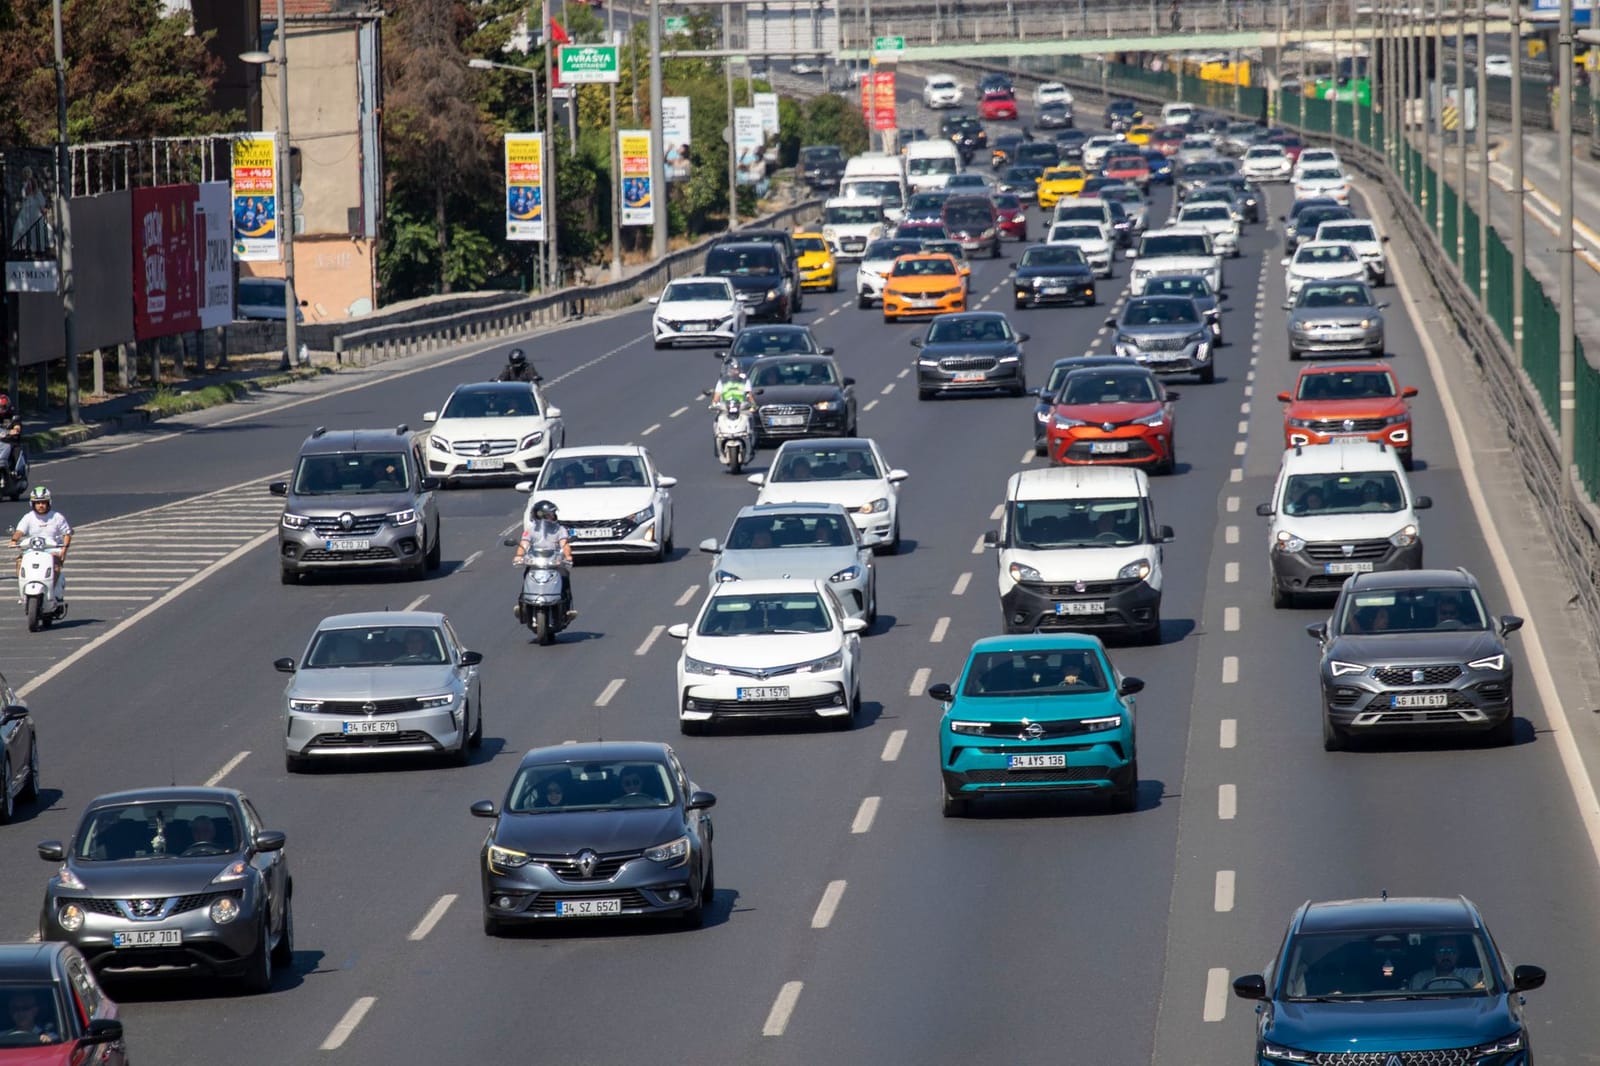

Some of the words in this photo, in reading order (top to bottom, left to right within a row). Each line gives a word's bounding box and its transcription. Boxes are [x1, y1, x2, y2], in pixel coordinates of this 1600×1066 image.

[566, 54, 611, 63] AVRASYA
[743, 689, 752, 698] 34
[756, 688, 765, 697] SA
[769, 688, 788, 697] 1570
[1397, 697, 1407, 705] 46
[1410, 696, 1426, 705] AIV
[349, 723, 358, 732] 34
[362, 722, 377, 732] GVE
[380, 722, 395, 731] 678
[1014, 757, 1024, 766] 34
[1028, 756, 1044, 765] AYS
[1048, 756, 1063, 765] 136
[563, 903, 574, 913] 34
[579, 902, 591, 912] SZ
[596, 901, 619, 911] 6521
[120, 933, 132, 943] 34
[137, 932, 155, 943] ACP
[160, 931, 178, 942] 701
